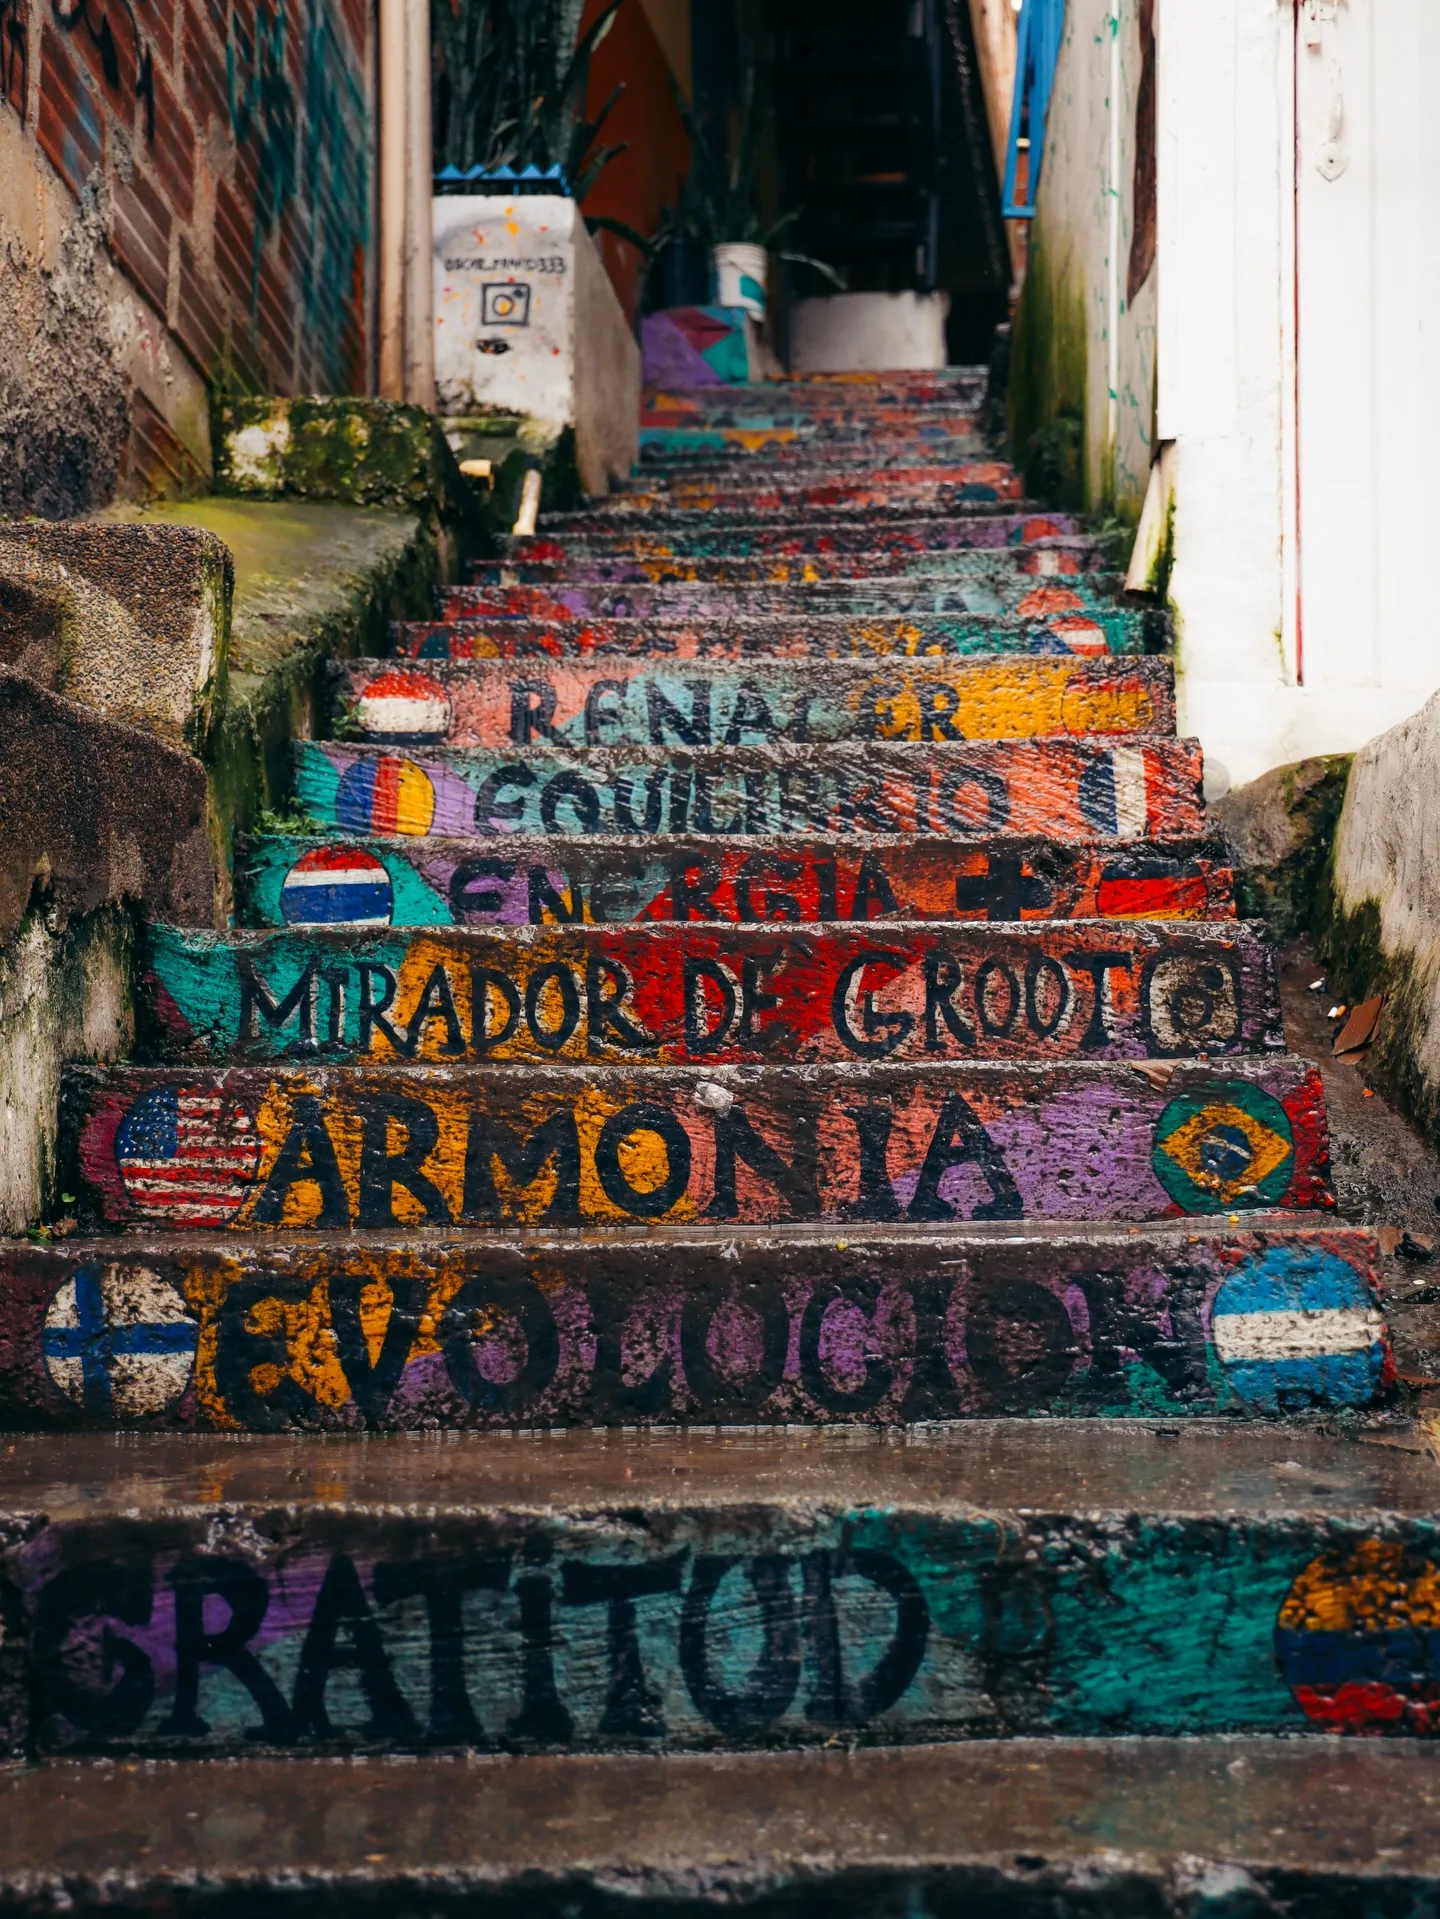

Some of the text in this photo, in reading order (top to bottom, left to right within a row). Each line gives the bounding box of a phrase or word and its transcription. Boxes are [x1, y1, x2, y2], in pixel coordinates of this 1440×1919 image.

[450, 855, 899, 923] ENERGIA
[239, 954, 660, 1059] MIRADOR
[685, 949, 787, 1056] DE
[246, 1086, 1024, 1224] ARMONIA
[36, 1548, 928, 1738] GRATITUD
